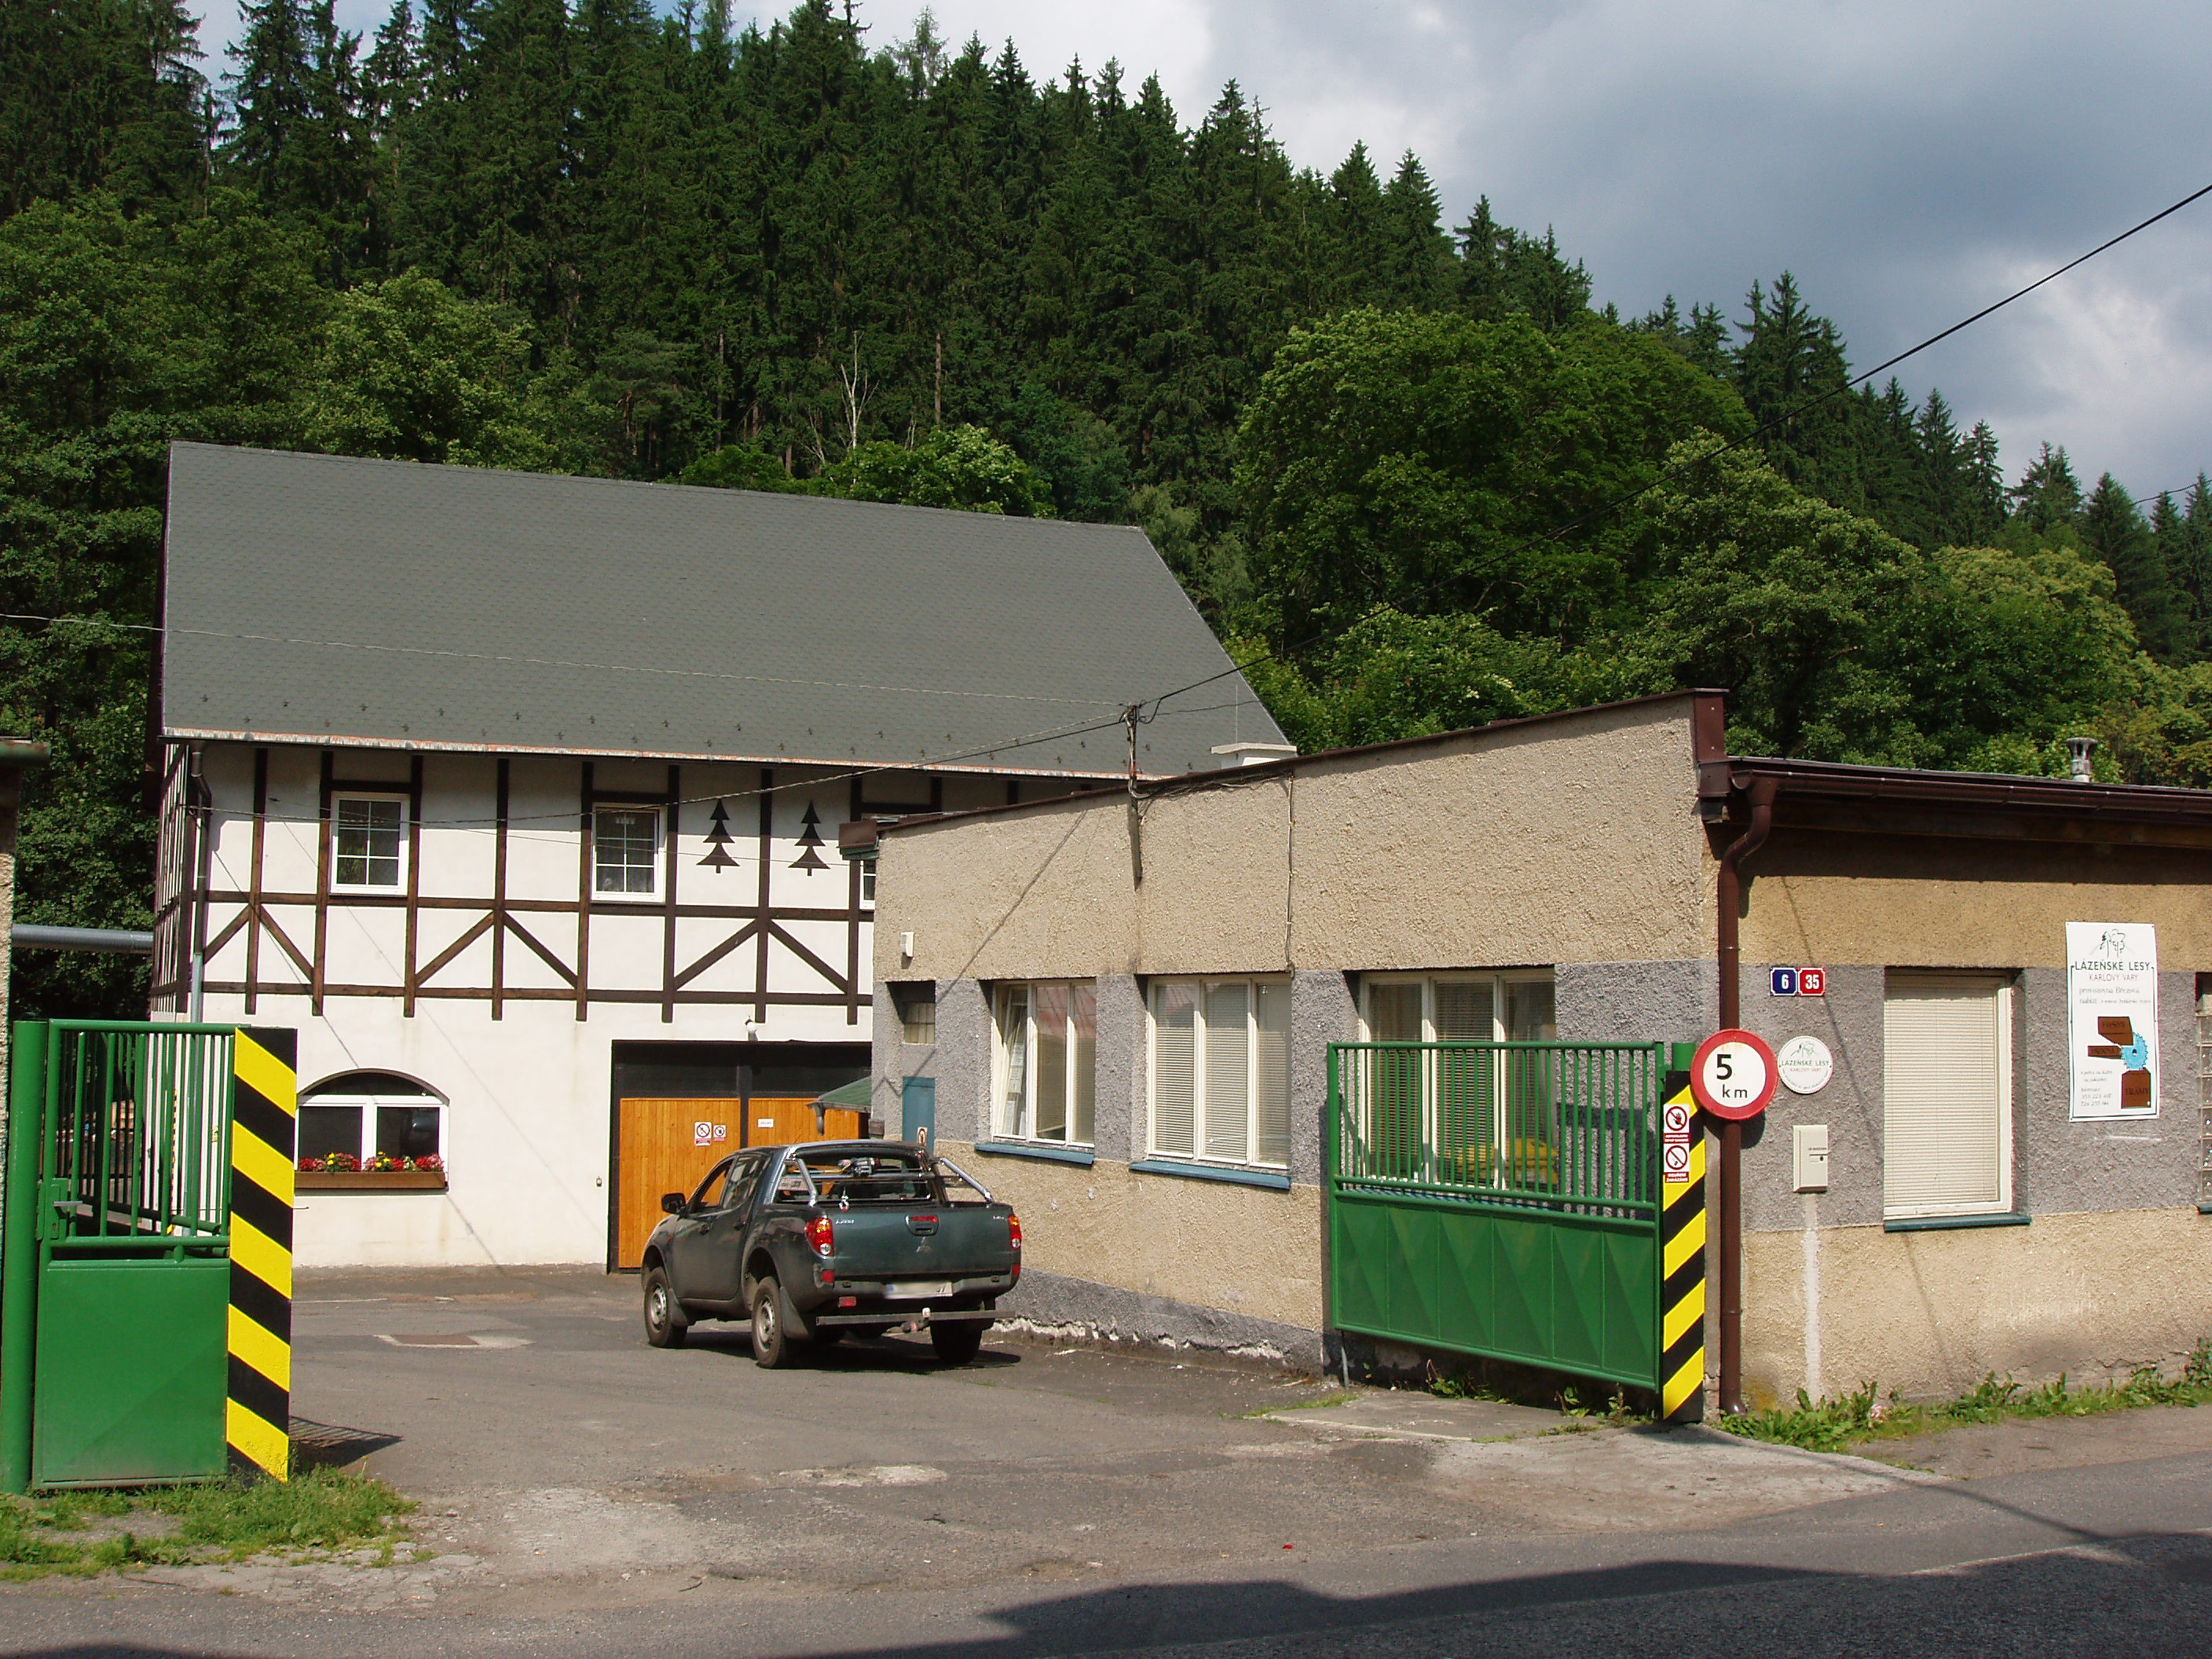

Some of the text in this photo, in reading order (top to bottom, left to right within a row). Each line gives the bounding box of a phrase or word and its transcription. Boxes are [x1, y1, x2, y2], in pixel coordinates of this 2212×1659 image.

[2129, 961, 2150, 971] LESY
[1781, 974, 1789, 990] 6
[1805, 974, 1820, 990] 35
[1716, 1053, 1733, 1080] 5
[1722, 1084, 1748, 1098] km
